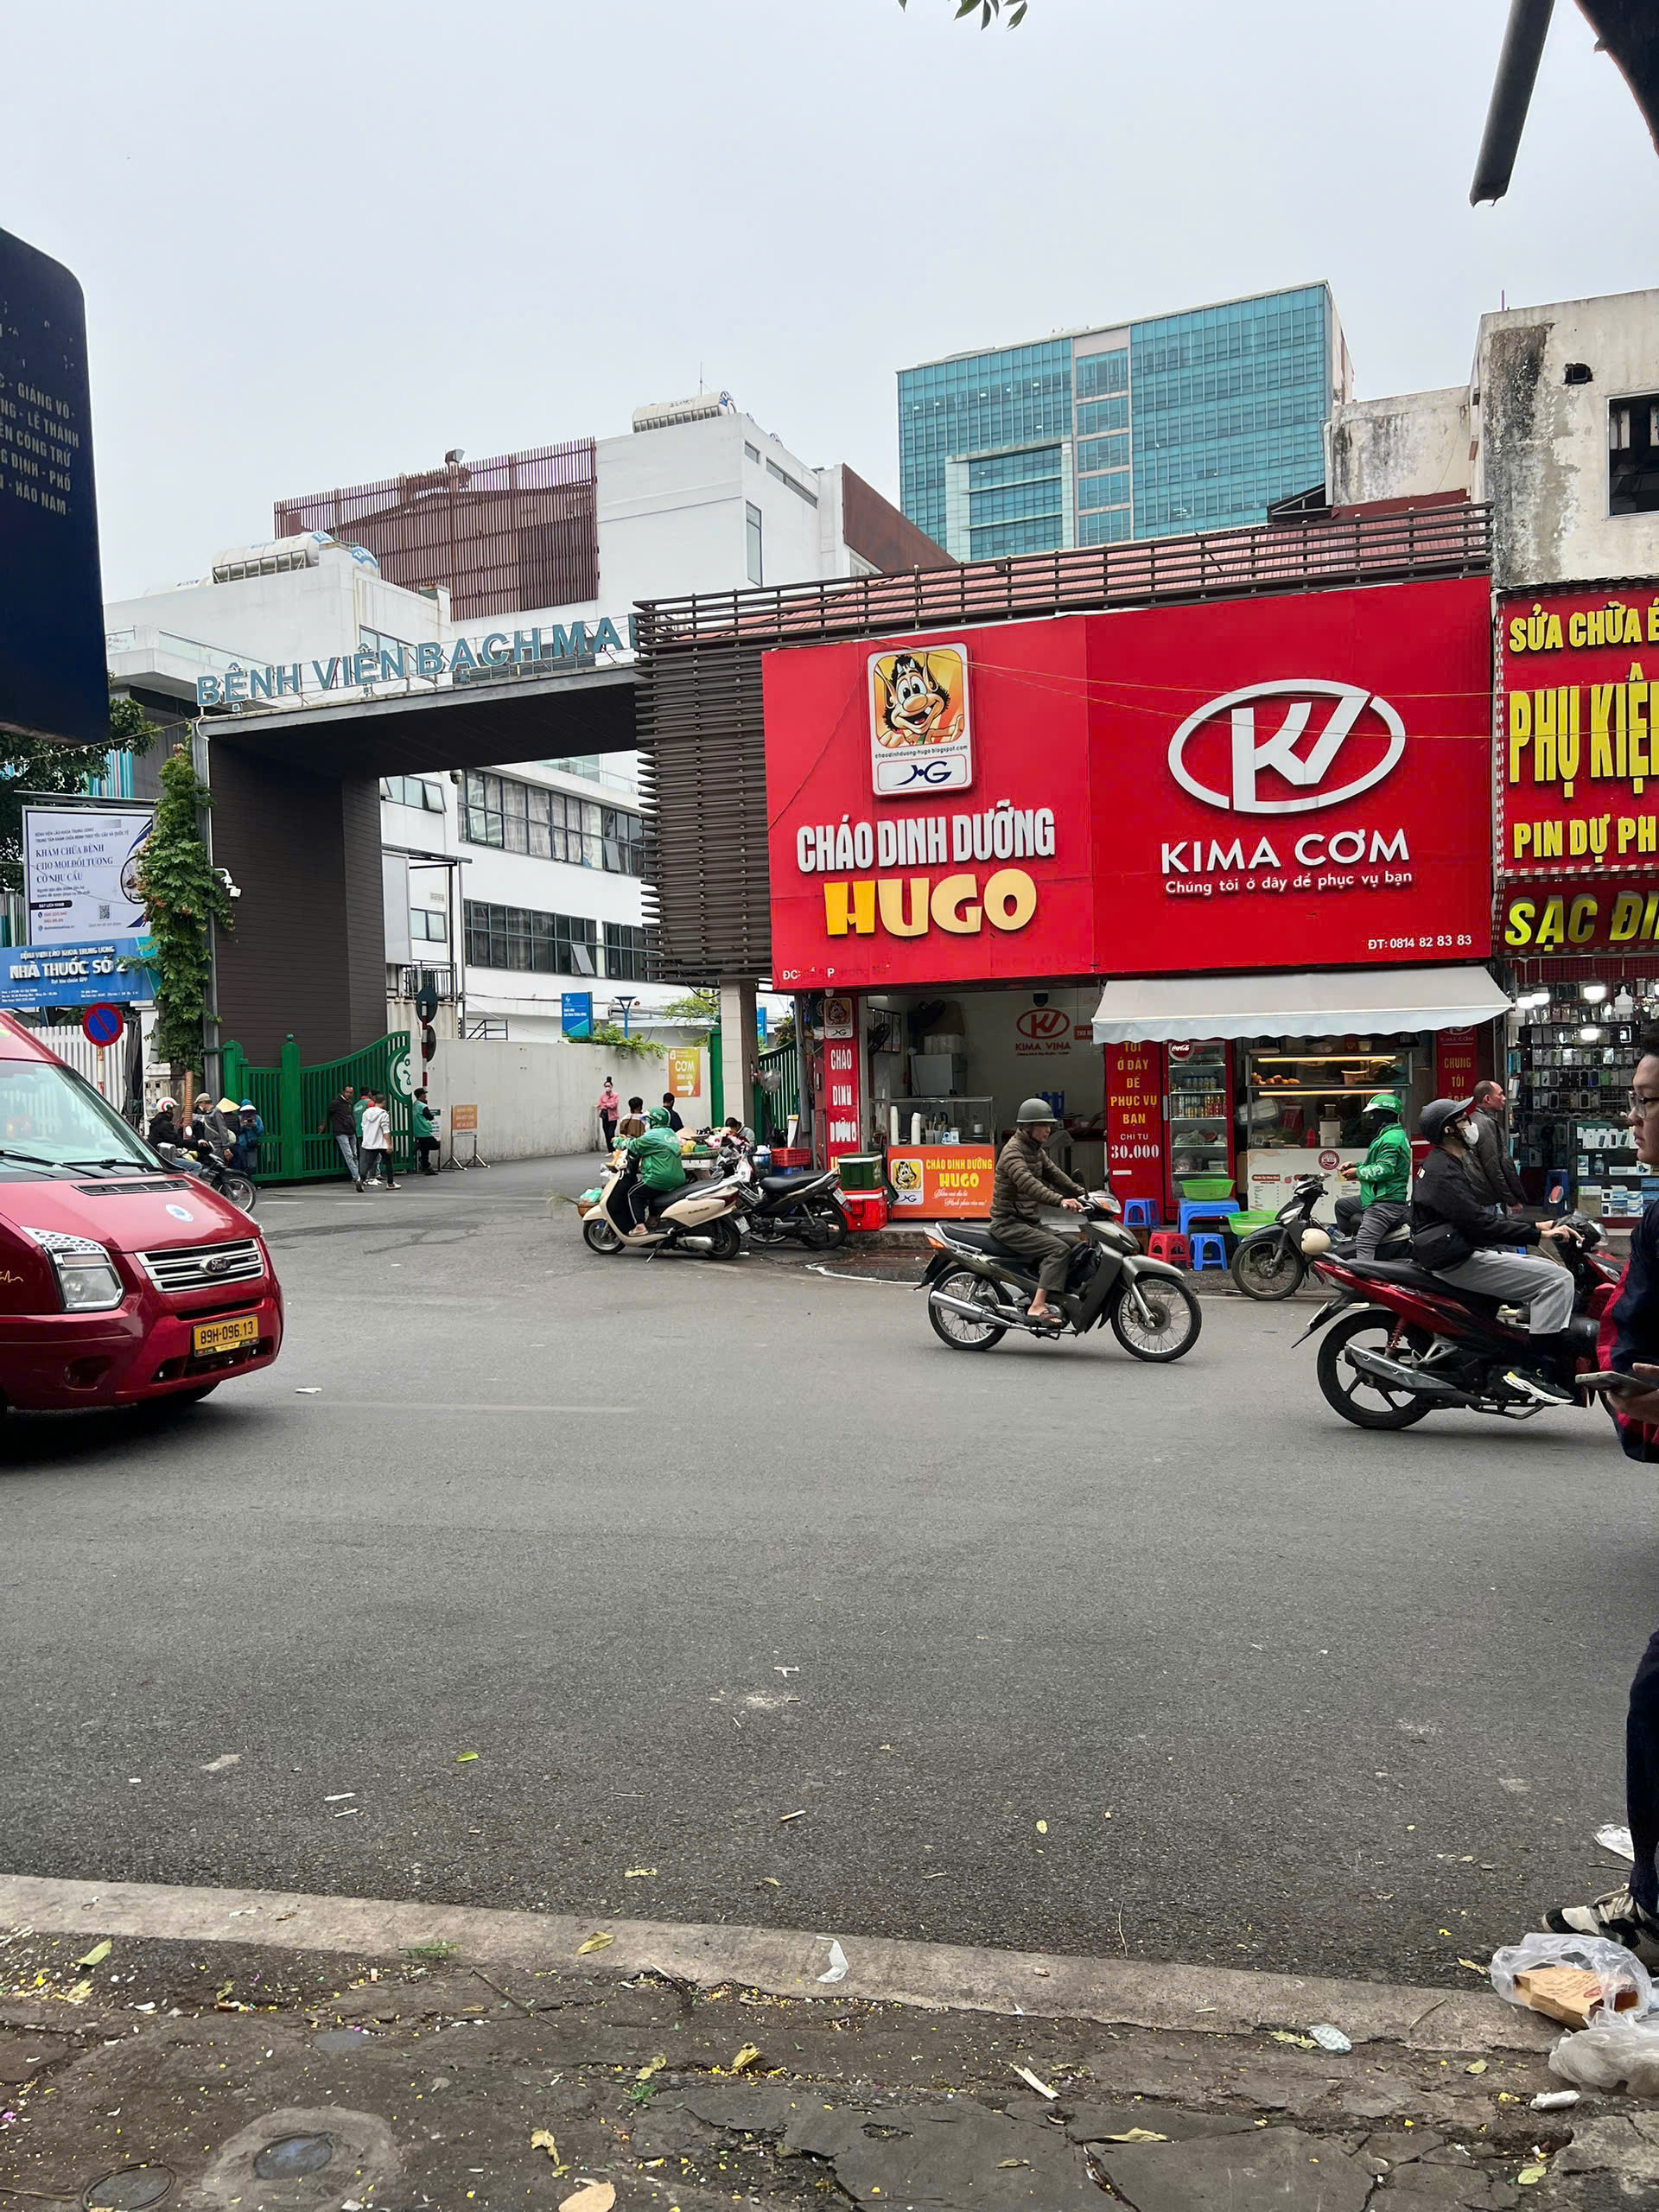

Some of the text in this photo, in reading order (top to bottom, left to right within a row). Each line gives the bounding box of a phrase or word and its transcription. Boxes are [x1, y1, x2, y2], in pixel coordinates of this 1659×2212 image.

[41, 491, 67, 516] NAM
[1510, 603, 1564, 652] SỬA
[1569, 601, 1643, 648] CHỮA
[1510, 685, 1580, 798] PHỤ
[797, 800, 1056, 873] CHÁO DINH DƯỠNG
[1514, 818, 1563, 859] PIN
[1570, 814, 1611, 863] DỰ
[1161, 829, 1410, 874] KIMA CƠM
[1166, 880, 1212, 896] Chúng
[1219, 876, 1239, 891] tôi
[1246, 876, 1256, 889] ở
[1318, 872, 1355, 891] phục
[1362, 874, 1379, 887] vụ
[1384, 869, 1413, 886] bạn
[823, 868, 1037, 937] HUGO
[1505, 891, 1659, 952] SẠC ĐI
[1368, 934, 1471, 950] ĐT: 0814 82 83 83
[10, 961, 41, 980] NHÀ
[42, 956, 90, 977] THUỐC
[92, 955, 114, 975] SỐ
[830, 1045, 852, 1071] CHÁO
[1015, 1042, 1042, 1052] KIMA
[832, 1084, 852, 1107] DINH
[1122, 1113, 1146, 1127] BẠN
[1110, 1143, 1160, 1159] 30.000
[925, 1157, 946, 1171] CHÁO
[947, 1159, 965, 1170] DINH
[939, 1173, 980, 1188] HUGO
[211, 1258, 227, 1271] Ford
[200, 1320, 254, 1345] 89H-096.13
